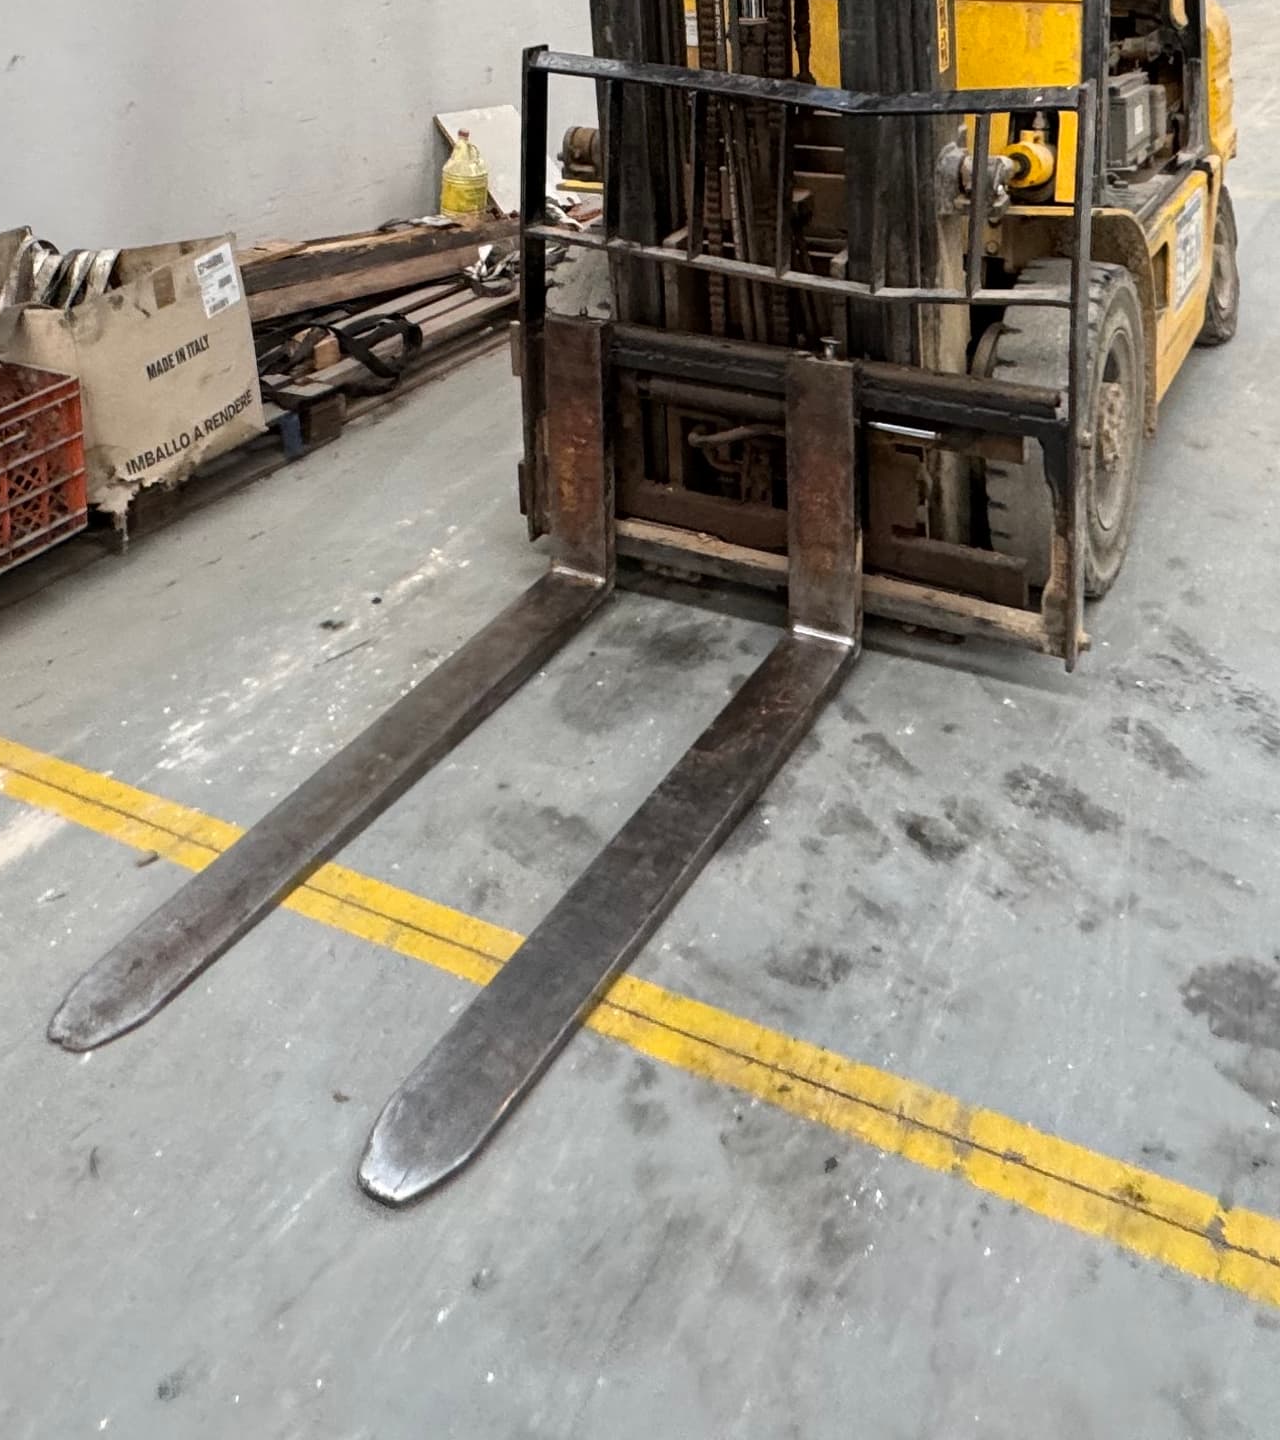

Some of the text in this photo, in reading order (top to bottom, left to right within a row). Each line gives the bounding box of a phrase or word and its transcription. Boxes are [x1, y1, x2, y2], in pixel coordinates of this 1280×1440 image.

[146, 334, 210, 380] MADE IN ITALY
[126, 389, 253, 475] IMBALLO A RENDERE
